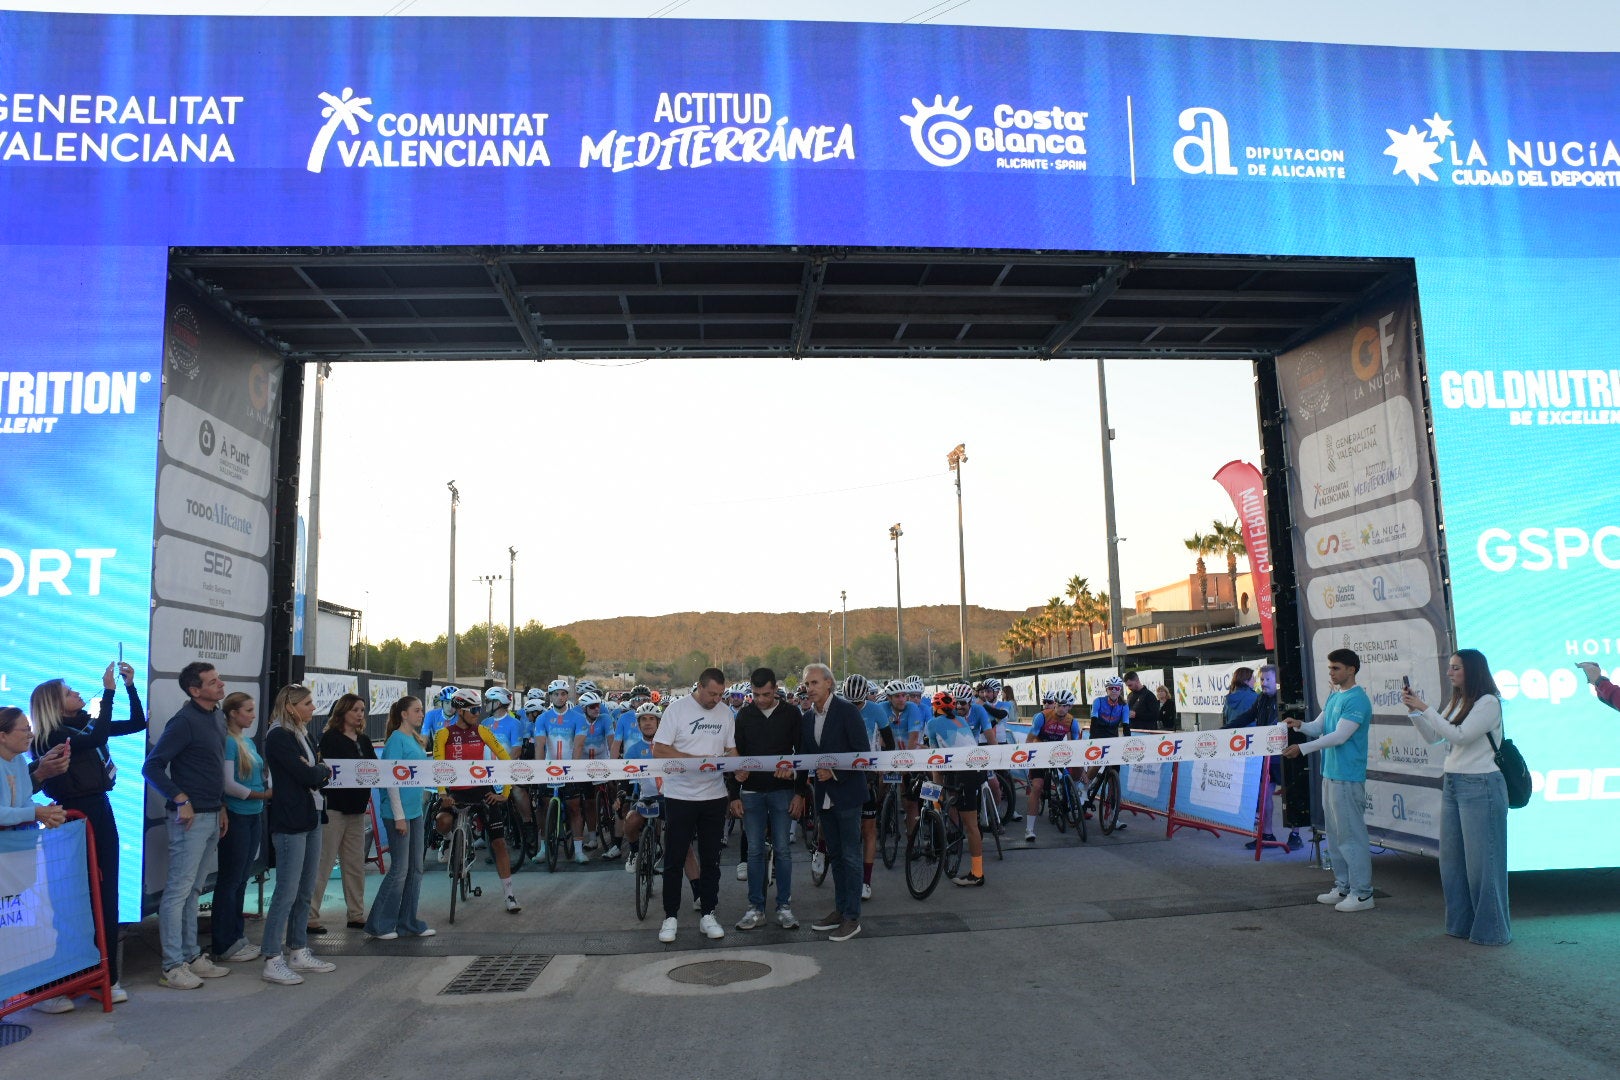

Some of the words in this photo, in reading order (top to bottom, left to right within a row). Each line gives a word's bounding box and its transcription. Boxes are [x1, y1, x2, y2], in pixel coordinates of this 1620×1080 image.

[654, 92, 772, 125] ACTITUD
[993, 103, 1086, 132] Costa
[377, 112, 549, 138] COMUNITAT
[337, 139, 551, 168] VALENCIANA
[579, 116, 856, 173] MEDITERRÁNEA
[975, 130, 1087, 155] Blanca
[1245, 146, 1345, 162] DIPUTACION
[1450, 138, 1488, 167] LA
[996, 157, 1049, 170] ALICANTE
[1055, 159, 1087, 170] SPAIN
[1247, 163, 1269, 178] DE
[1272, 164, 1346, 179] ALICANTE
[1451, 169, 1515, 186] CIUDAD
[1517, 170, 1548, 187] DEL
[1354, 386, 1365, 401] LA
[1510, 411, 1533, 426] BE
[1335, 424, 1377, 449] GENERALITAT
[220, 435, 228, 457] À
[230, 444, 250, 467] Punt
[1336, 438, 1378, 460] VALENCIANA
[183, 627, 242, 653] GOLDNUTRITION
[1353, 639, 1398, 652] GENERALITAT
[1360, 651, 1399, 664] ALENCIANA
[689, 716, 723, 735] Tommy
